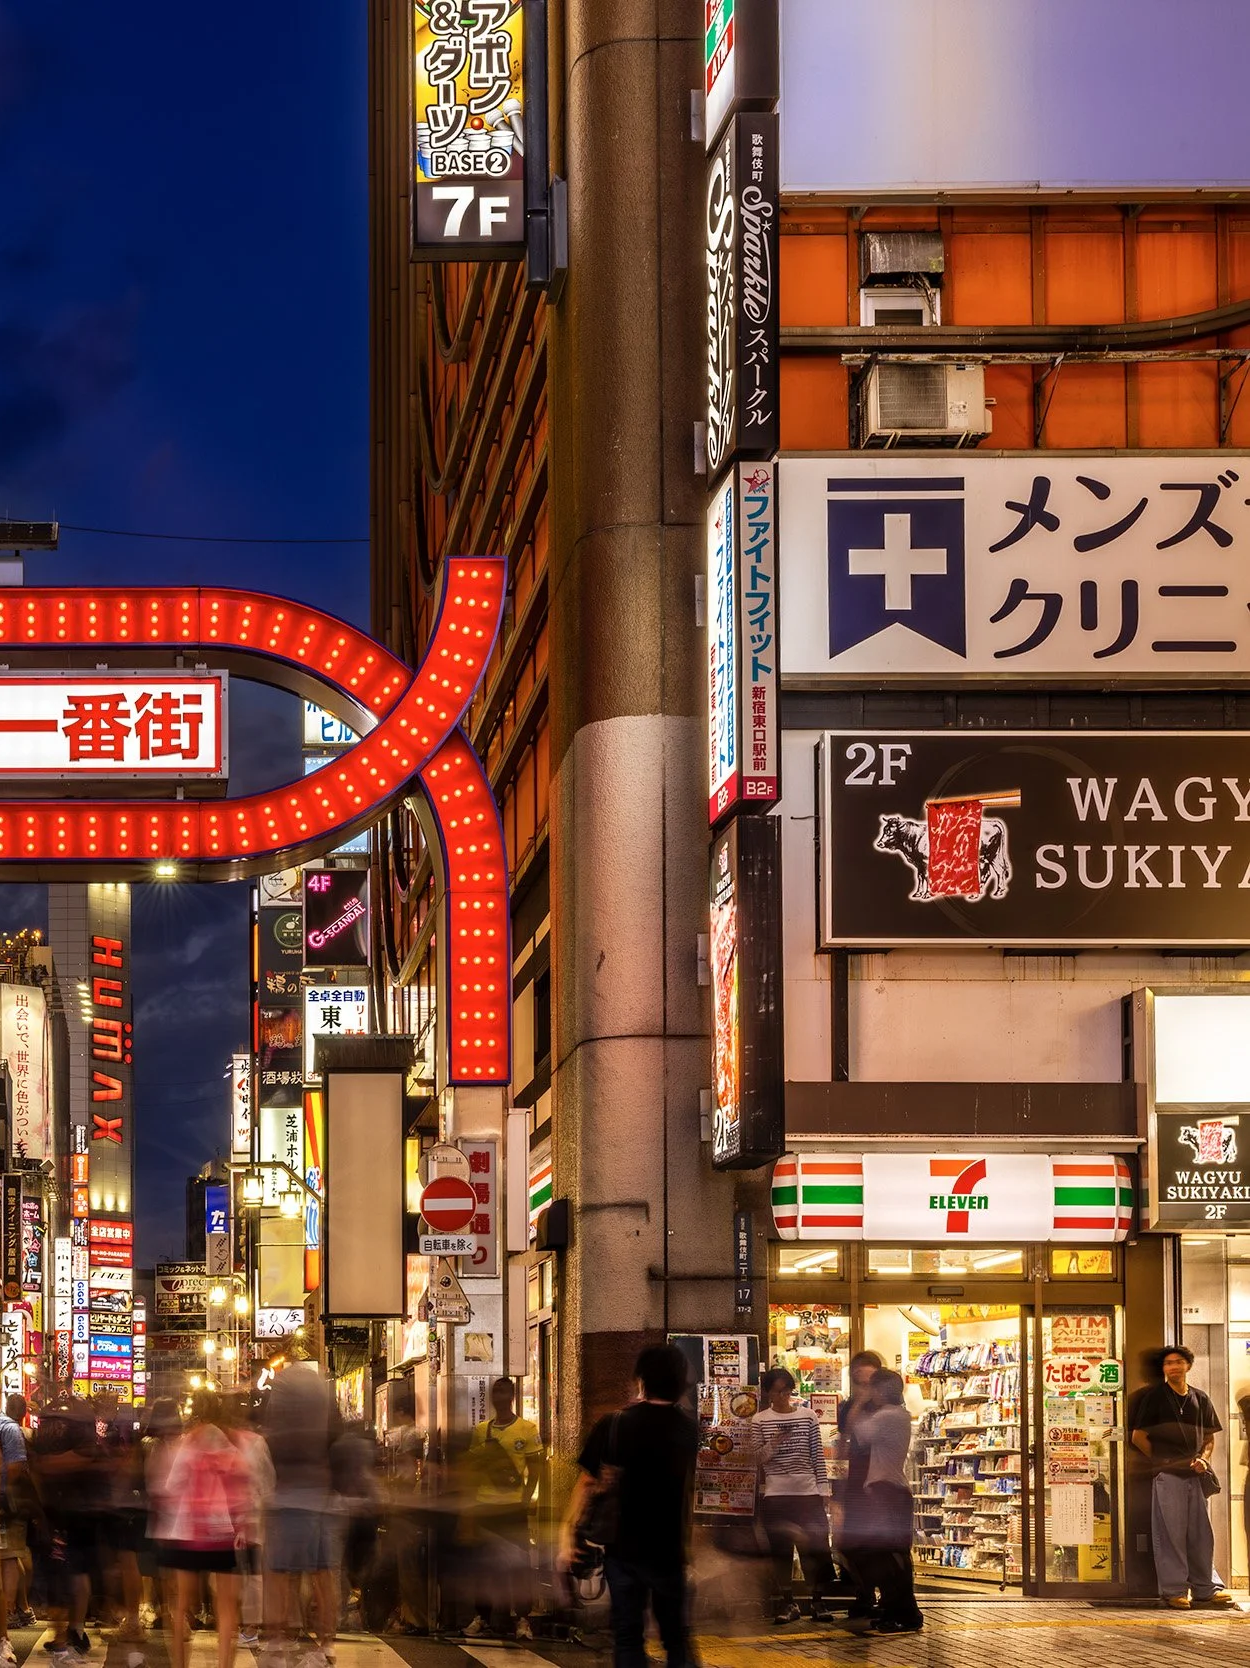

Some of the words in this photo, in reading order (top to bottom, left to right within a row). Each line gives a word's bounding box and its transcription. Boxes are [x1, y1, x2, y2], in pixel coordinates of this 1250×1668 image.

[751, 133, 763, 182] 歌舞伎町
[432, 185, 510, 237] 7F
[740, 185, 773, 324] Sparkle
[744, 329, 772, 428] スパークル
[989, 469, 1250, 553] メンズ
[743, 495, 772, 682] ファイトフィット
[989, 579, 1250, 659] クリニ
[751, 686, 767, 771] 新宿東口駅前
[844, 742, 912, 786] 2F
[745, 781, 774, 796] B2F
[1034, 844, 1250, 889] SUKIY
[307, 875, 331, 892] 4F
[308, 990, 366, 1002] 全卓全自動
[1175, 1170, 1242, 1185] WAGYU
[1205, 1204, 1227, 1220] 2F
[91, 1226, 131, 1240] 全店営業中
[423, 1239, 473, 1252] 自転車を除く
[77, 1281, 85, 1305] GiGO
[737, 1289, 751, 1300] 17
[77, 1315, 85, 1339] GiGO
[1052, 1316, 1108, 1329] ATM
[1045, 1363, 1091, 1383] たばこ
[1099, 1363, 1119, 1383] 酒
